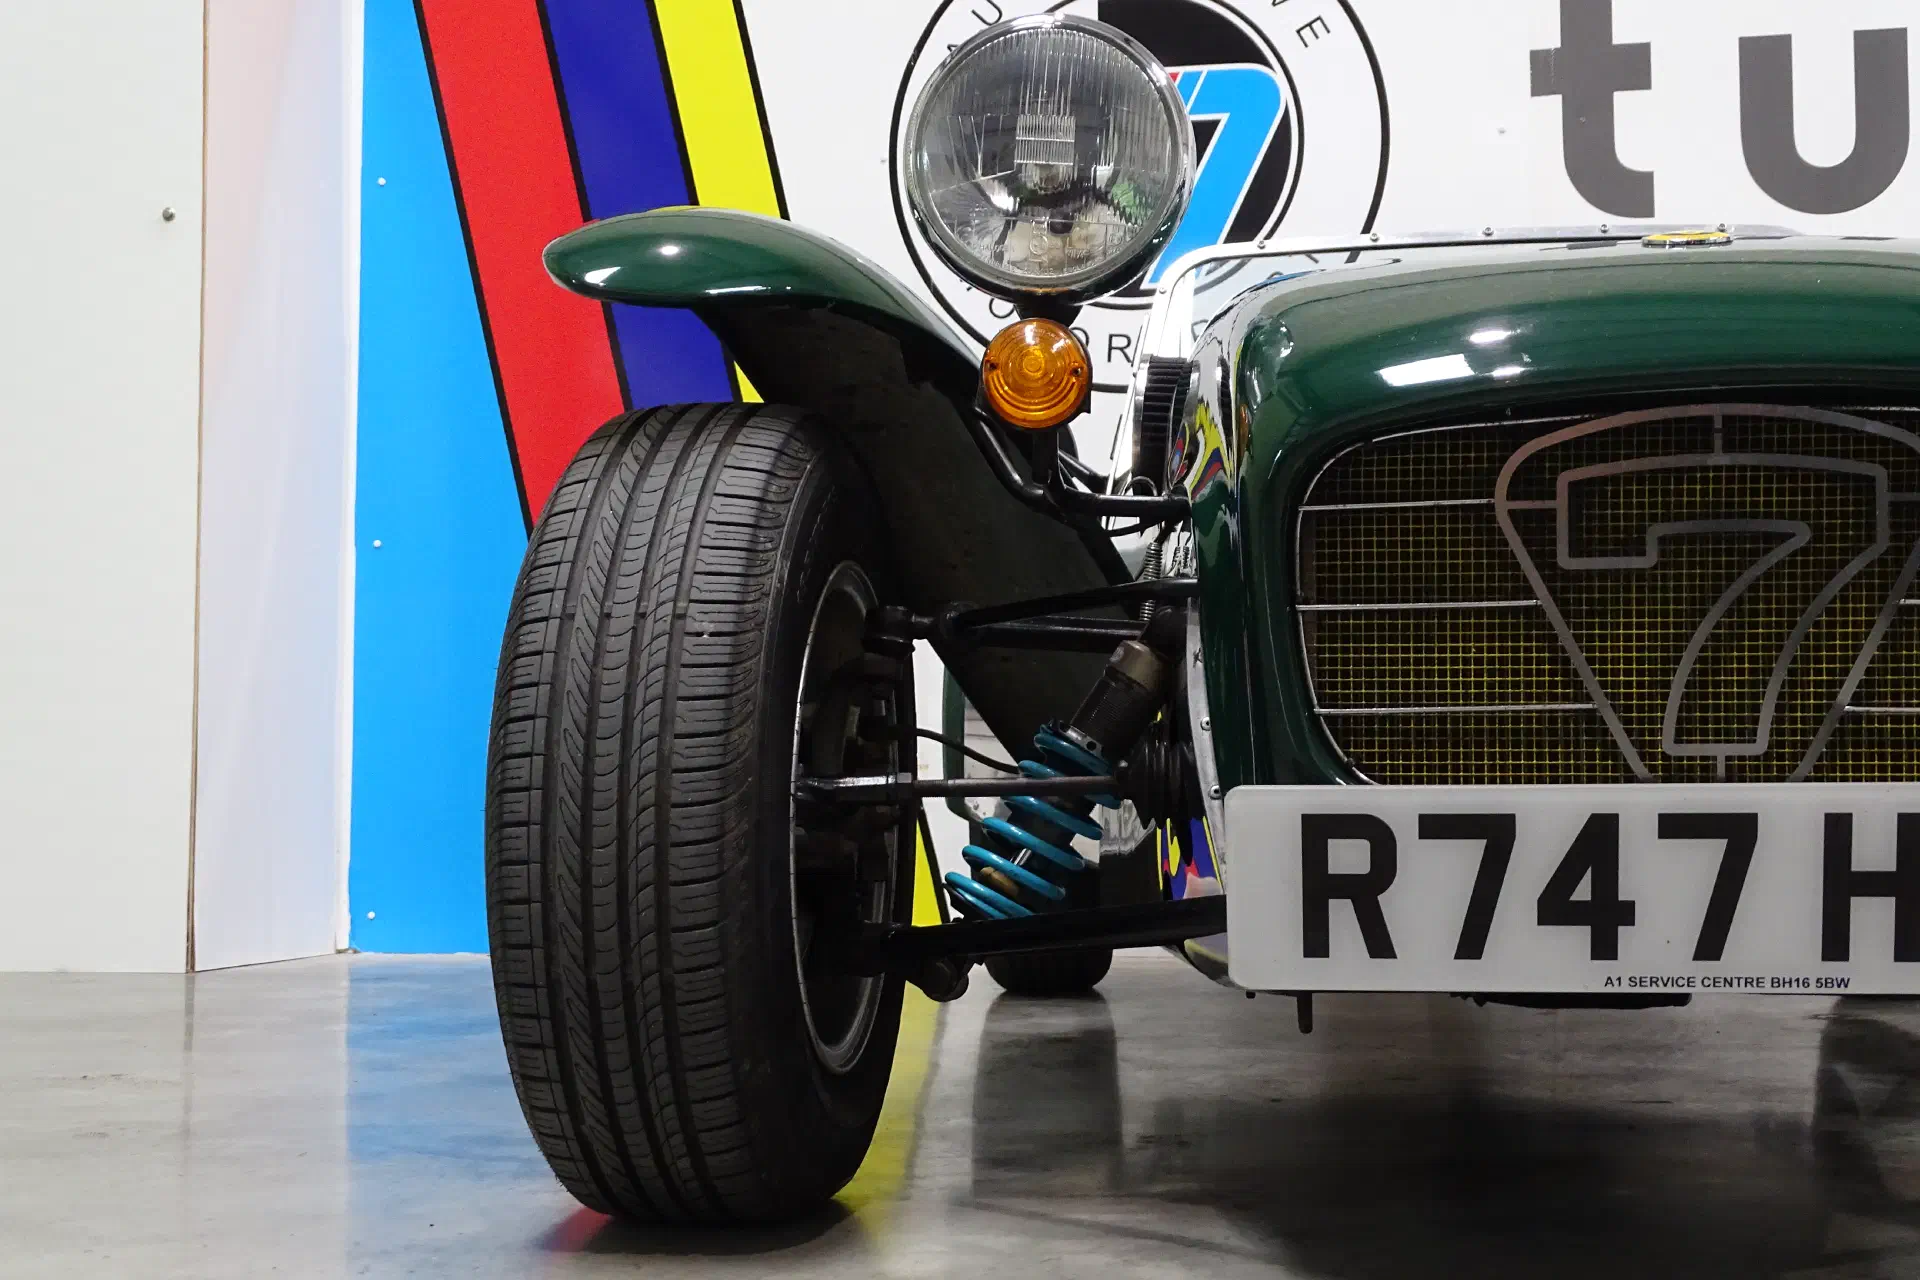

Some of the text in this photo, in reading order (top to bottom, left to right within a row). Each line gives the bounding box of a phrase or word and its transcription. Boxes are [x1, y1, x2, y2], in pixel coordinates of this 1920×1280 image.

[1301, 812, 1759, 962] R747
[1603, 975, 1851, 989] A1 SERVICE CENTRE BH16 5BW
